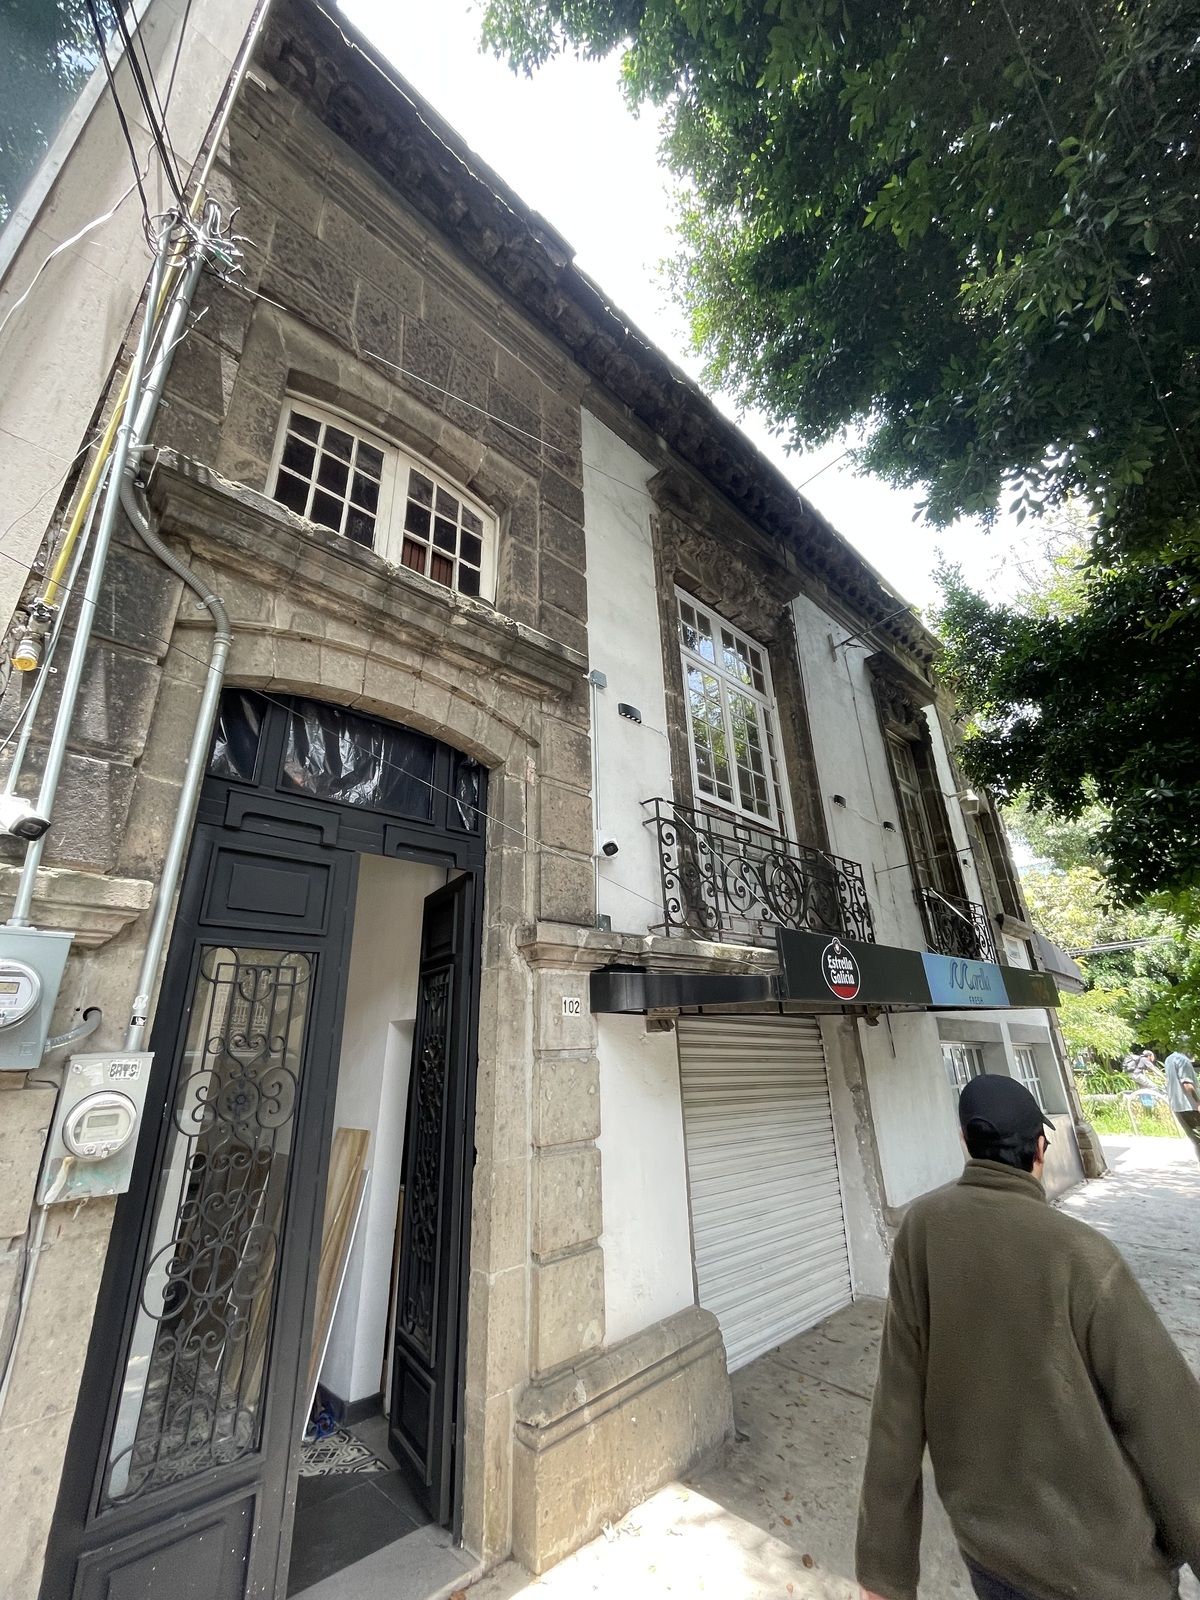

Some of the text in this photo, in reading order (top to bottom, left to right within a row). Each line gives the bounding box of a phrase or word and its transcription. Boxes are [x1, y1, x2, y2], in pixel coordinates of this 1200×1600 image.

[827, 955, 853, 970] Estrella
[831, 969, 855, 985] Galicia
[563, 999, 580, 1014] 102
